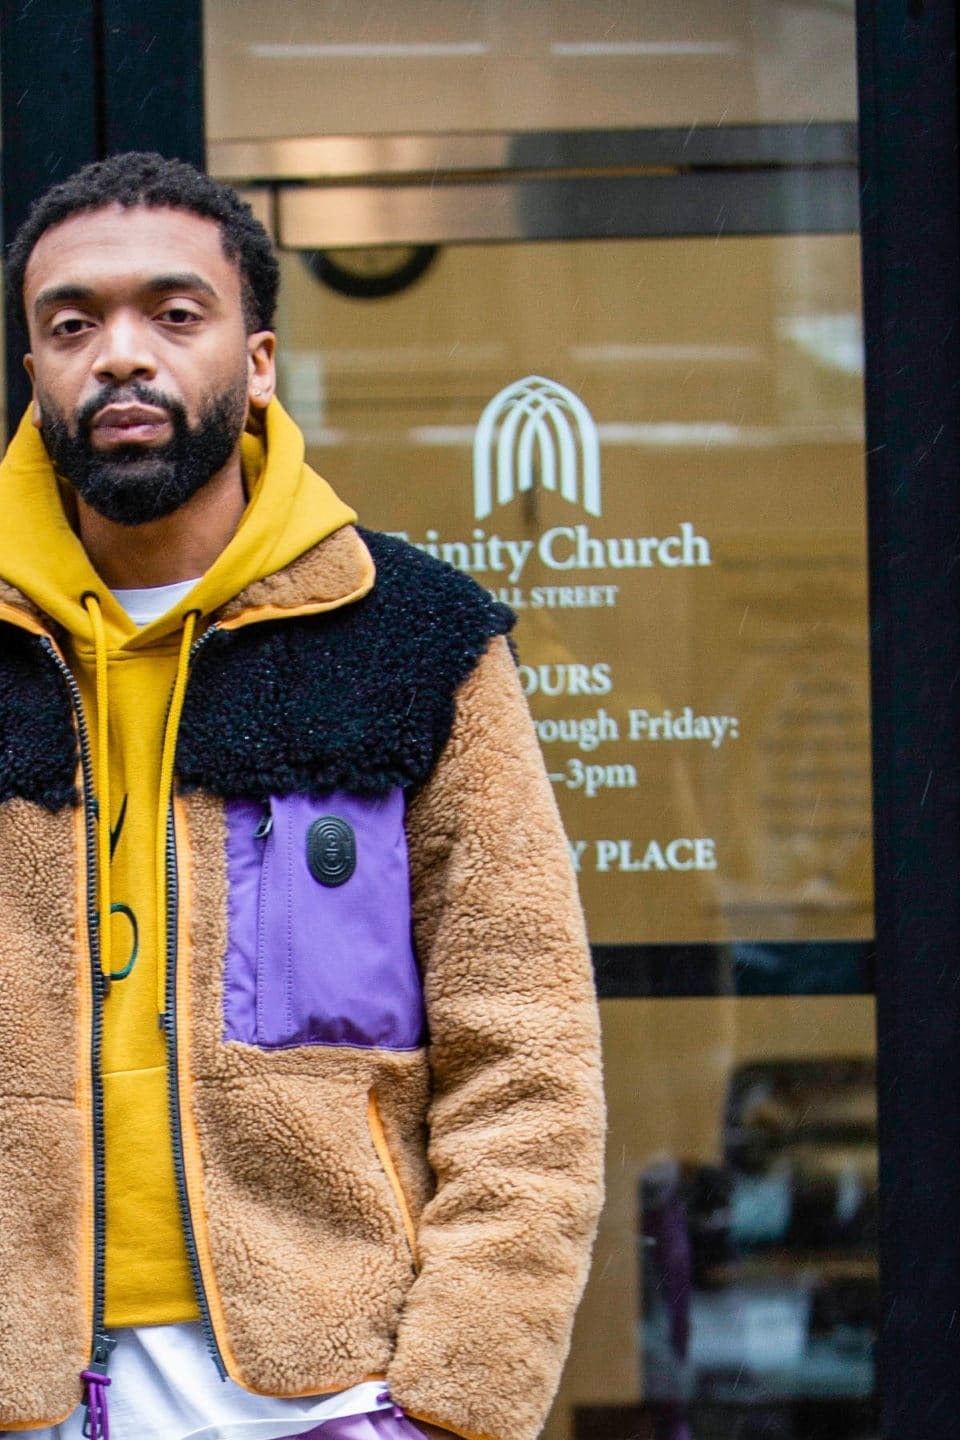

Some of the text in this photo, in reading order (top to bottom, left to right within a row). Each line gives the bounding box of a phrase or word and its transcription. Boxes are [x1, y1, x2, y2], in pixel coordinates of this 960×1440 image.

[539, 522, 712, 571] Church
[530, 584, 619, 608] STREET
[517, 663, 612, 696] OURS
[628, 706, 739, 748] Friday:
[549, 758, 637, 797] –3pm
[596, 838, 718, 872] PLACE
